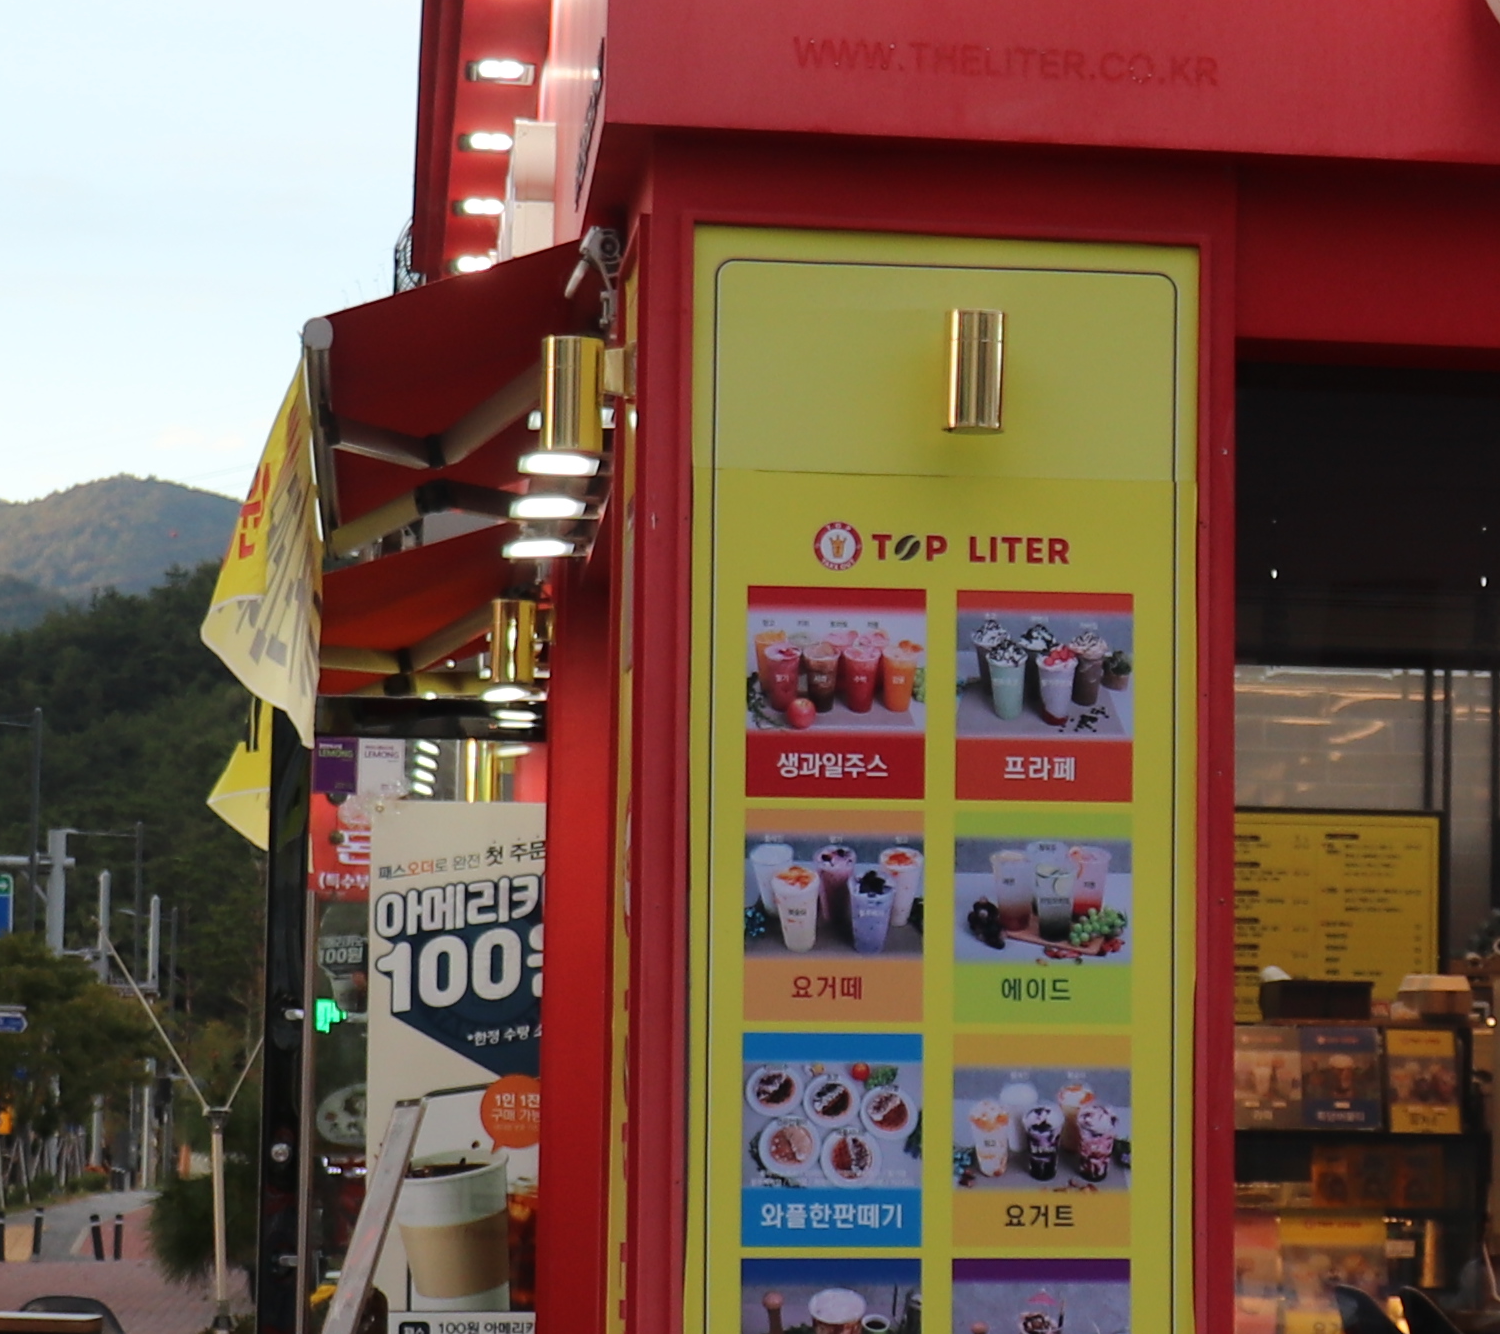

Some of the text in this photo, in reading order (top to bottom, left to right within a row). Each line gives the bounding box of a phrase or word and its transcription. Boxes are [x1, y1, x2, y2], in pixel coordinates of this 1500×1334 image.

[792, 35, 1219, 86] WWW.THELITER.CO.KR
[968, 535, 1071, 566] LITER
[776, 751, 889, 780] 생과일주스
[1003, 754, 1077, 782] 프라페
[453, 853, 482, 872] 완전
[486, 845, 504, 866] 첫
[790, 976, 864, 1001] 요거떼
[1000, 977, 1072, 1003] 에이드
[495, 1093, 516, 1108] 1인
[492, 1109, 516, 1122] 구매
[760, 1203, 903, 1230] 와플한판떼기
[1003, 1204, 1076, 1229] 요거트
